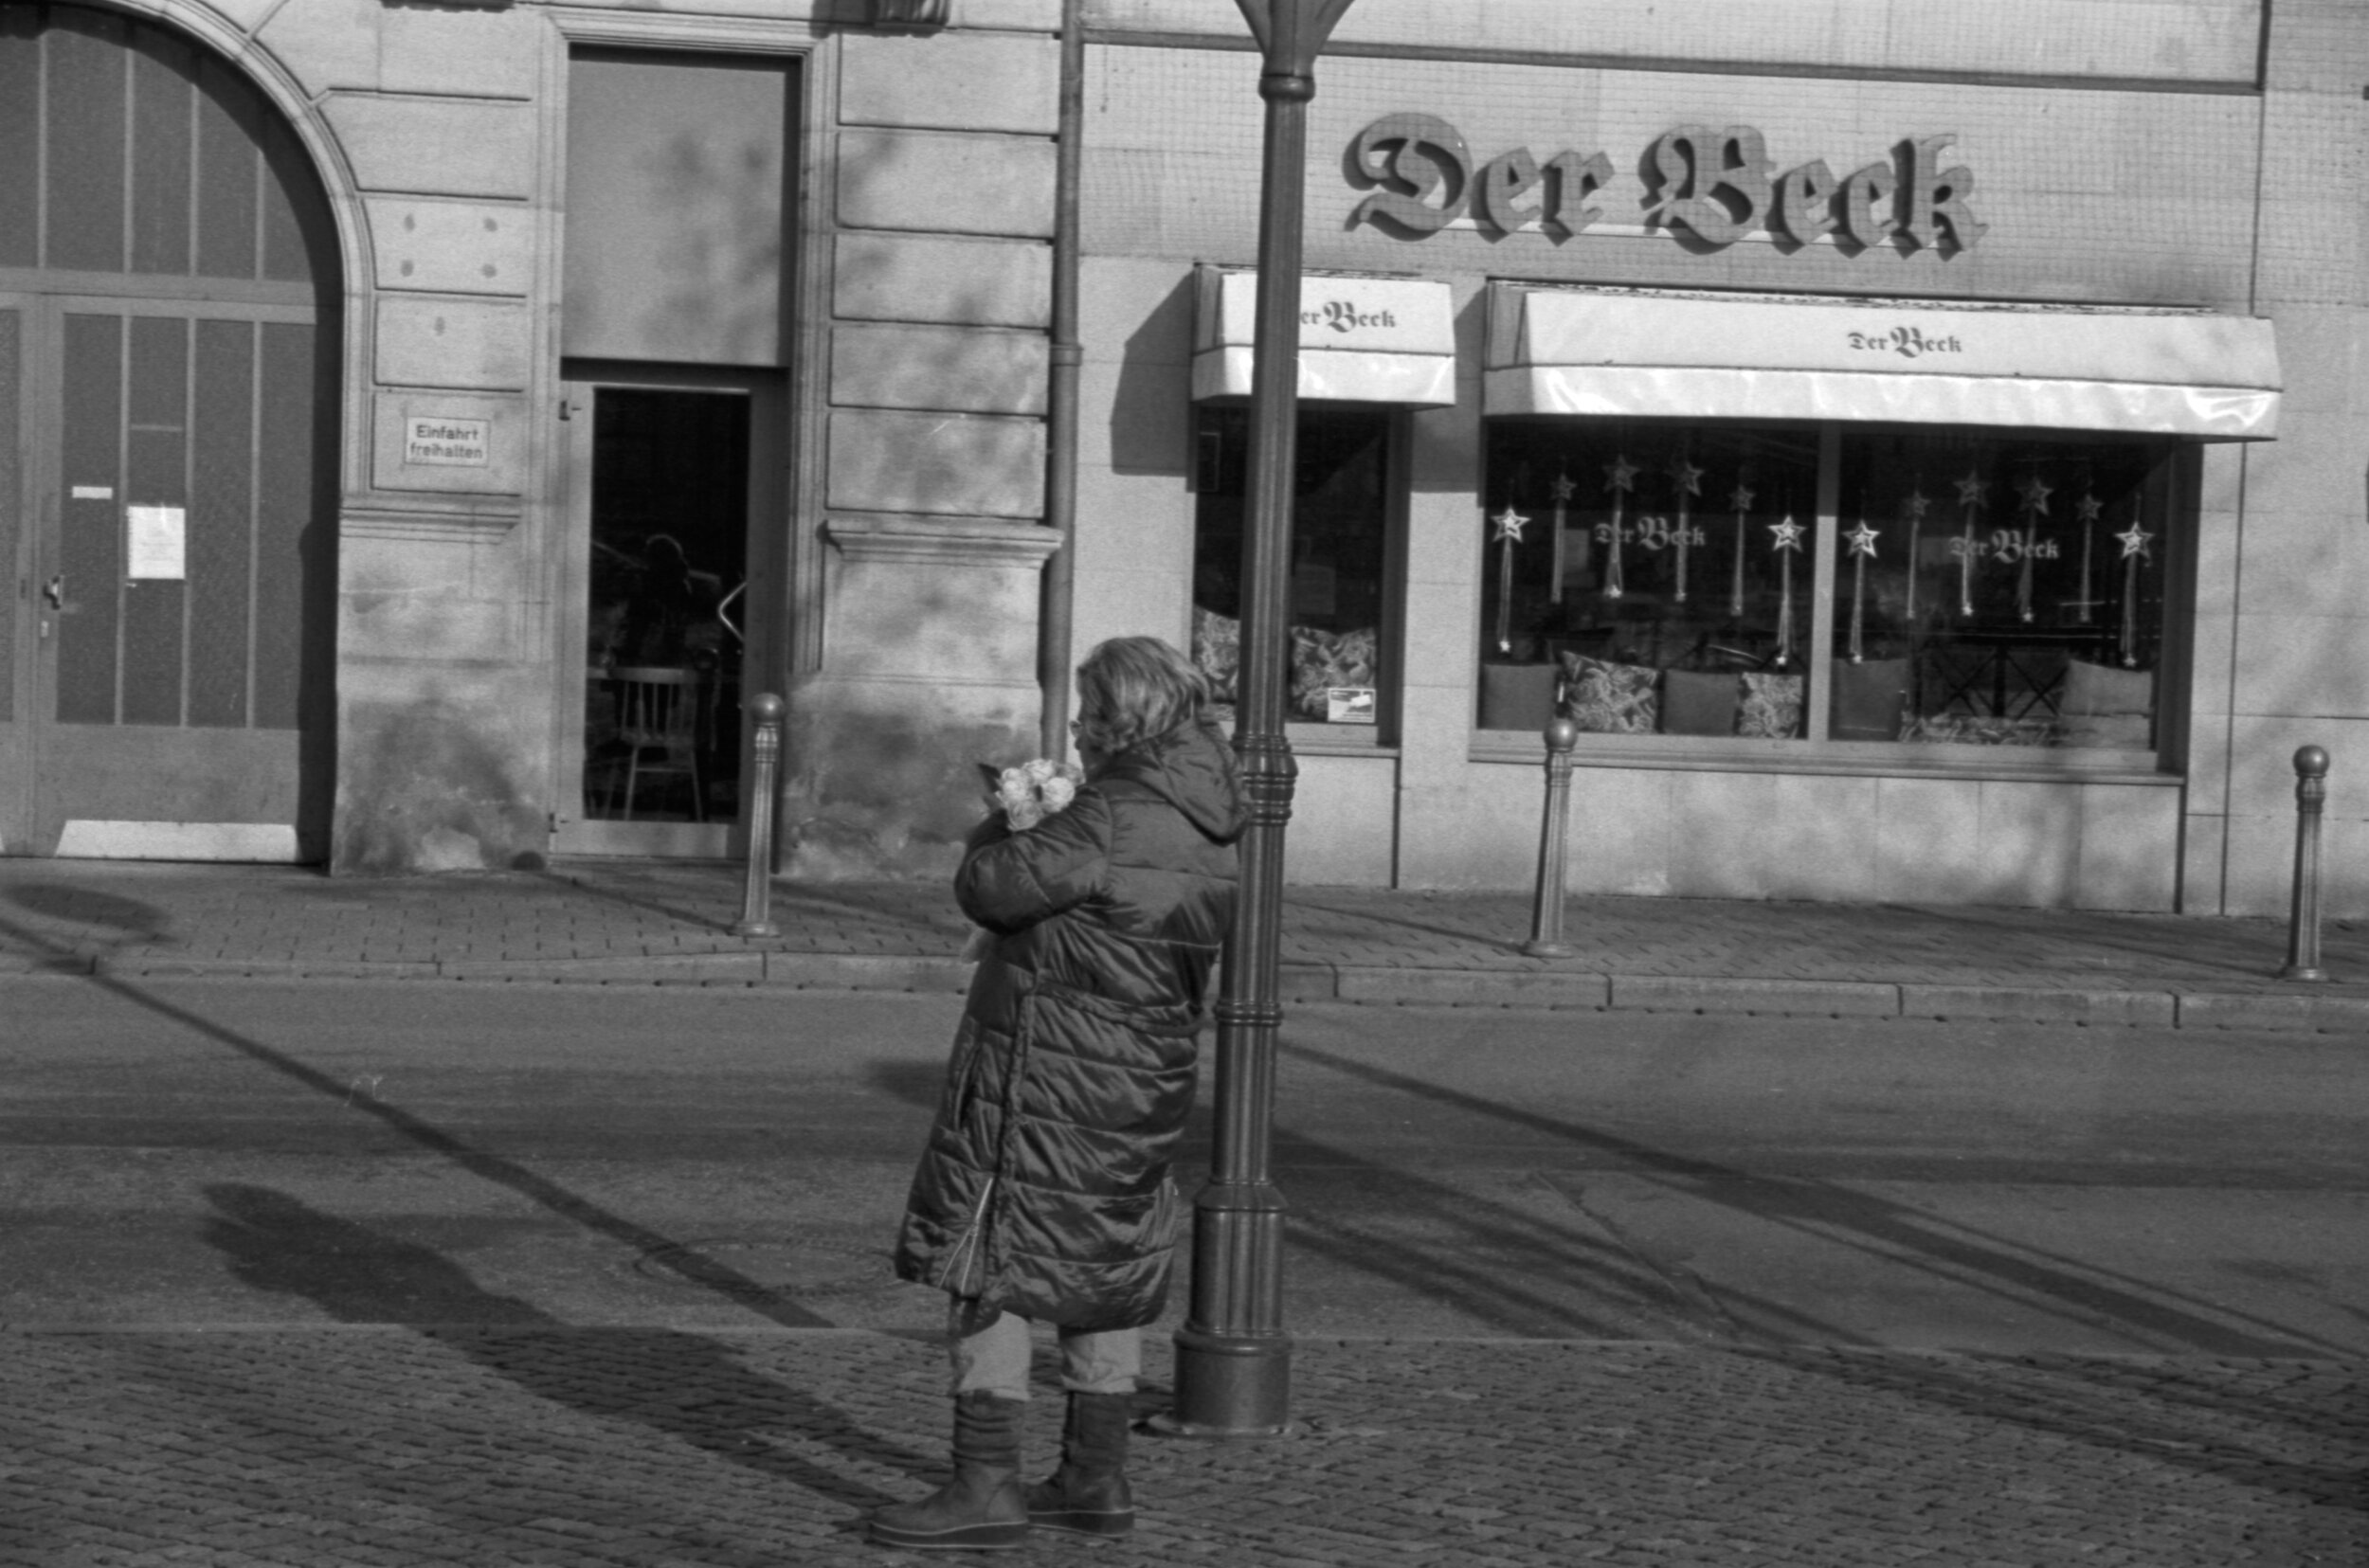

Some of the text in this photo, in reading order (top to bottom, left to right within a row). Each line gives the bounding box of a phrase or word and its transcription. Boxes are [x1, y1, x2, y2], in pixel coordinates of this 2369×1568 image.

[1343, 112, 1988, 261] Der Beck
[1299, 301, 1397, 333] er Beck
[1847, 326, 1962, 358] Der Beck
[416, 424, 479, 441] Einfahrt
[410, 442, 483, 460] freihalten
[1991, 529, 2060, 564] Beck
